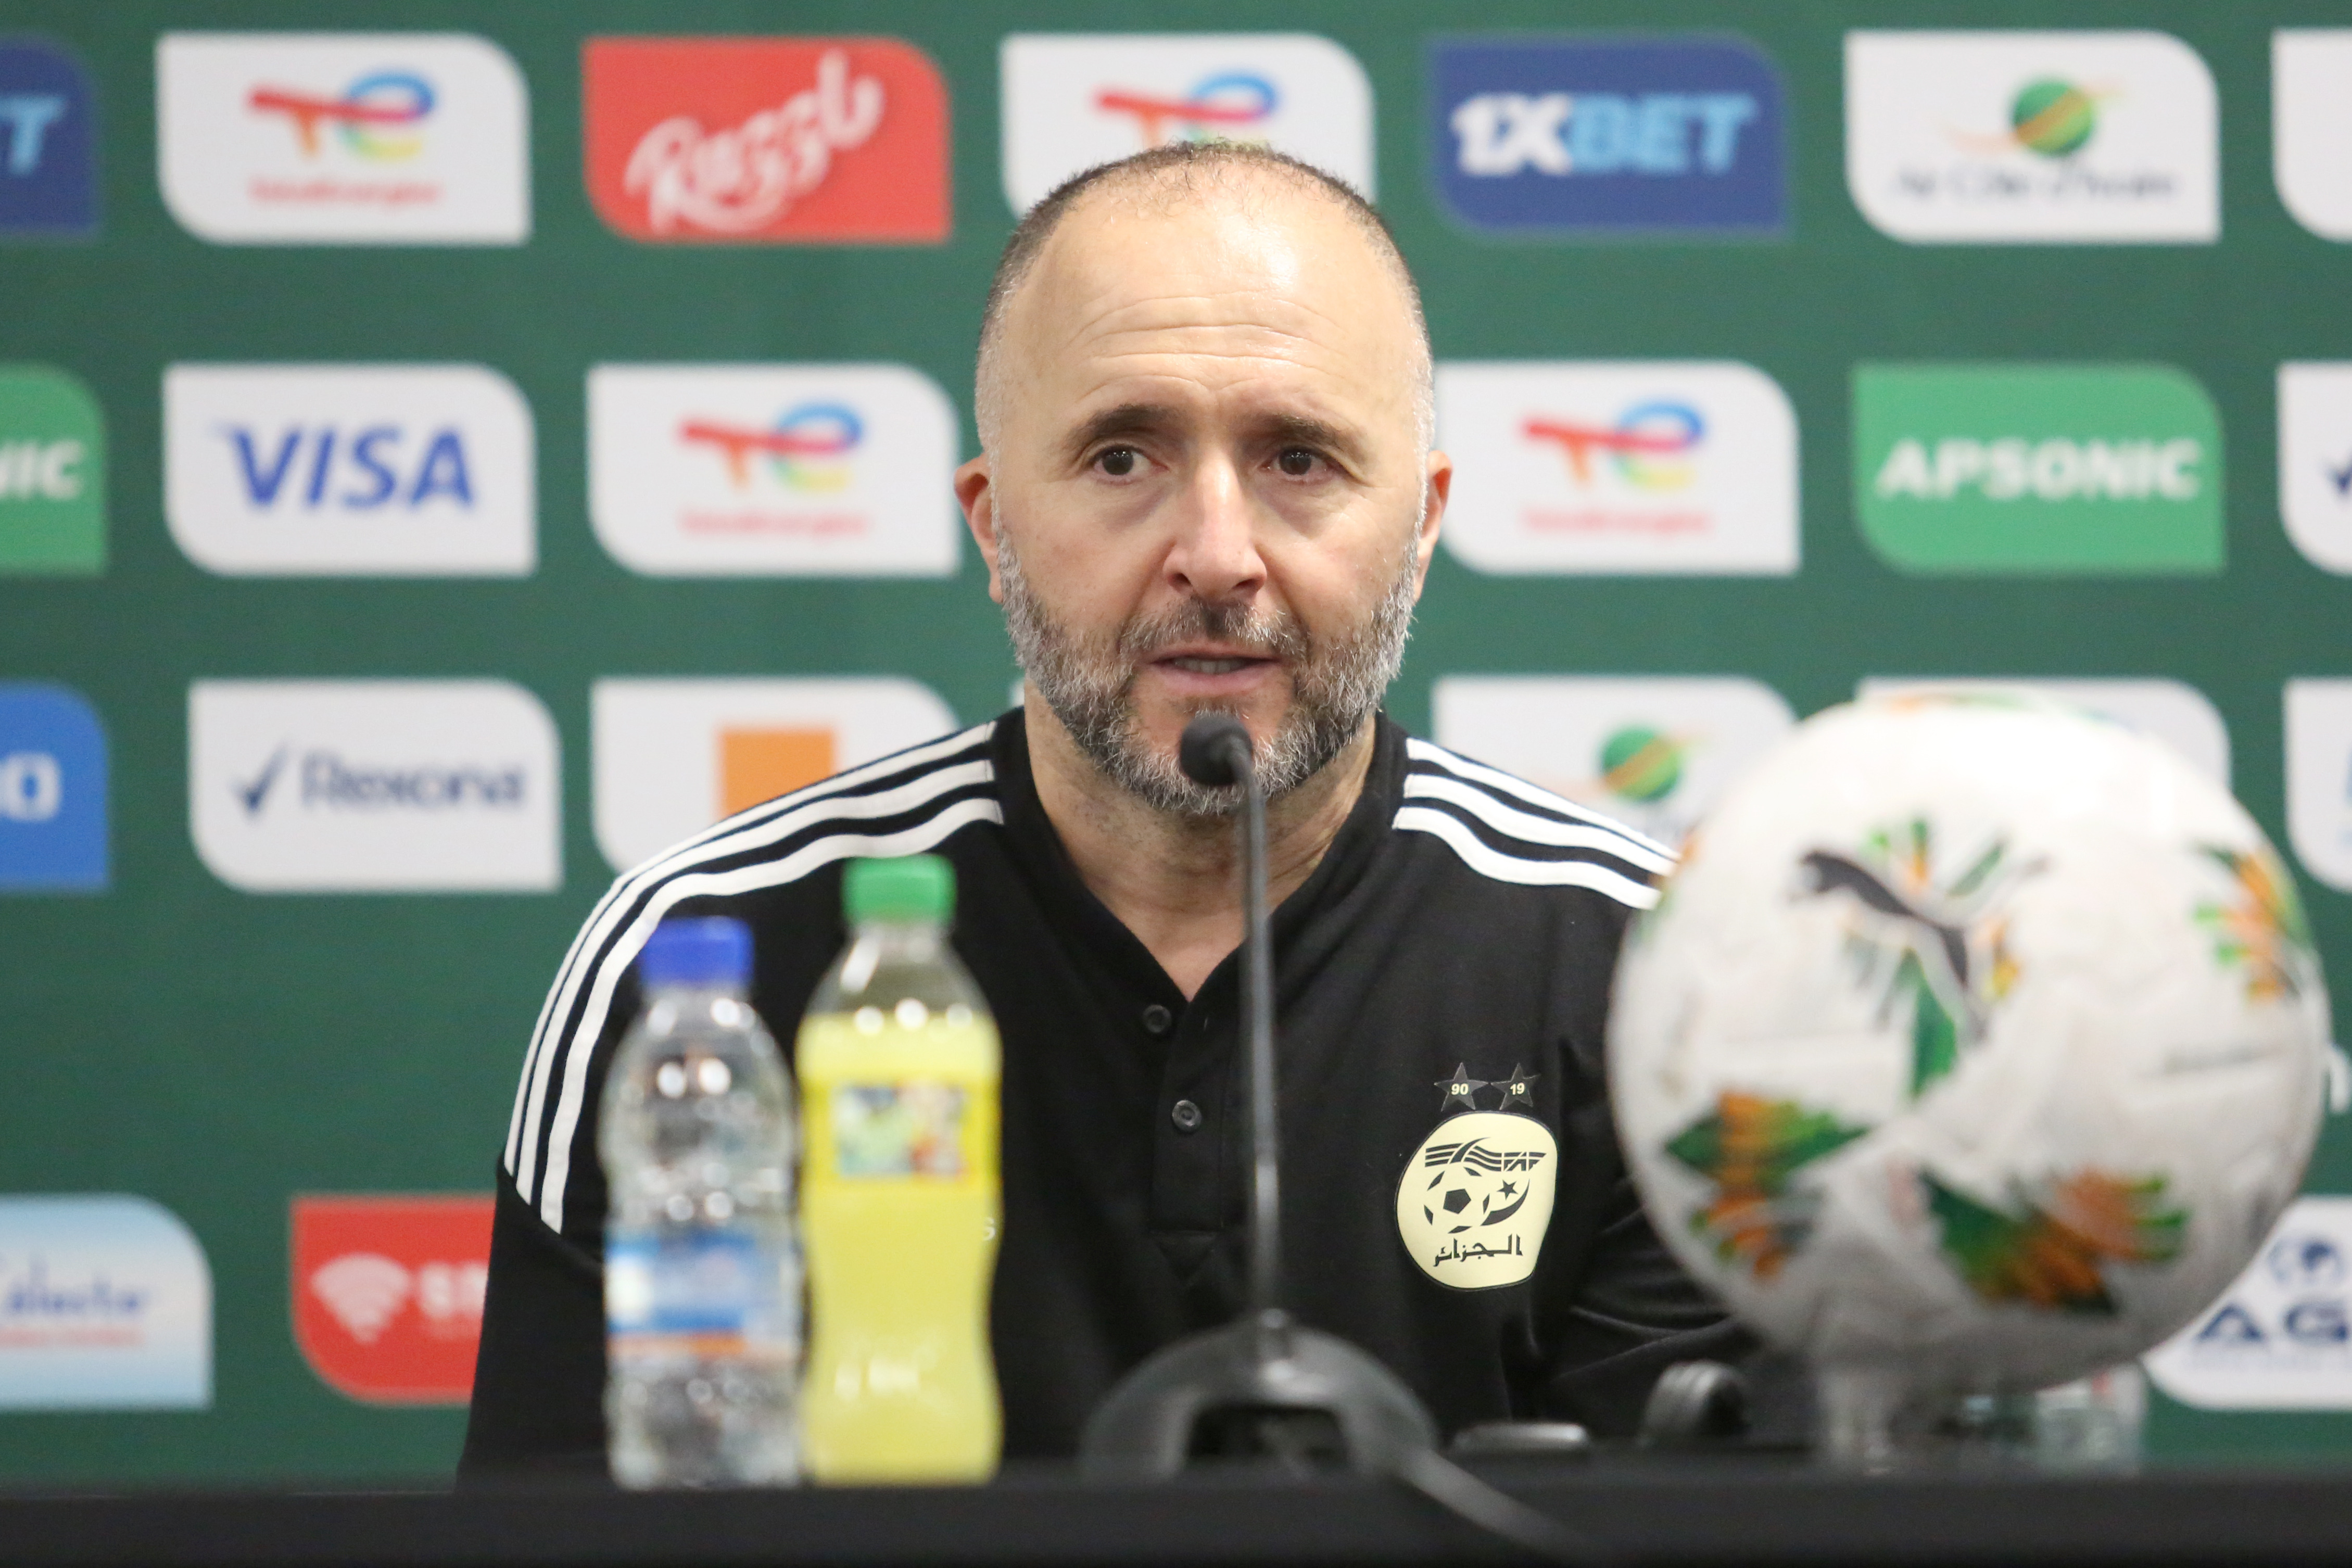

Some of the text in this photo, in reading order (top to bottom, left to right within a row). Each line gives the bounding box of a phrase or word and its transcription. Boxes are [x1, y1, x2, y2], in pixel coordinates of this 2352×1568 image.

[1451, 93, 1756, 177] 1XBET
[211, 426, 476, 510] VISA
[1875, 437, 2203, 501] APSONIC
[1451, 1082, 1469, 1095] 90
[1510, 1082, 1525, 1095] 19
[1433, 1234, 1523, 1267] الجزائر
